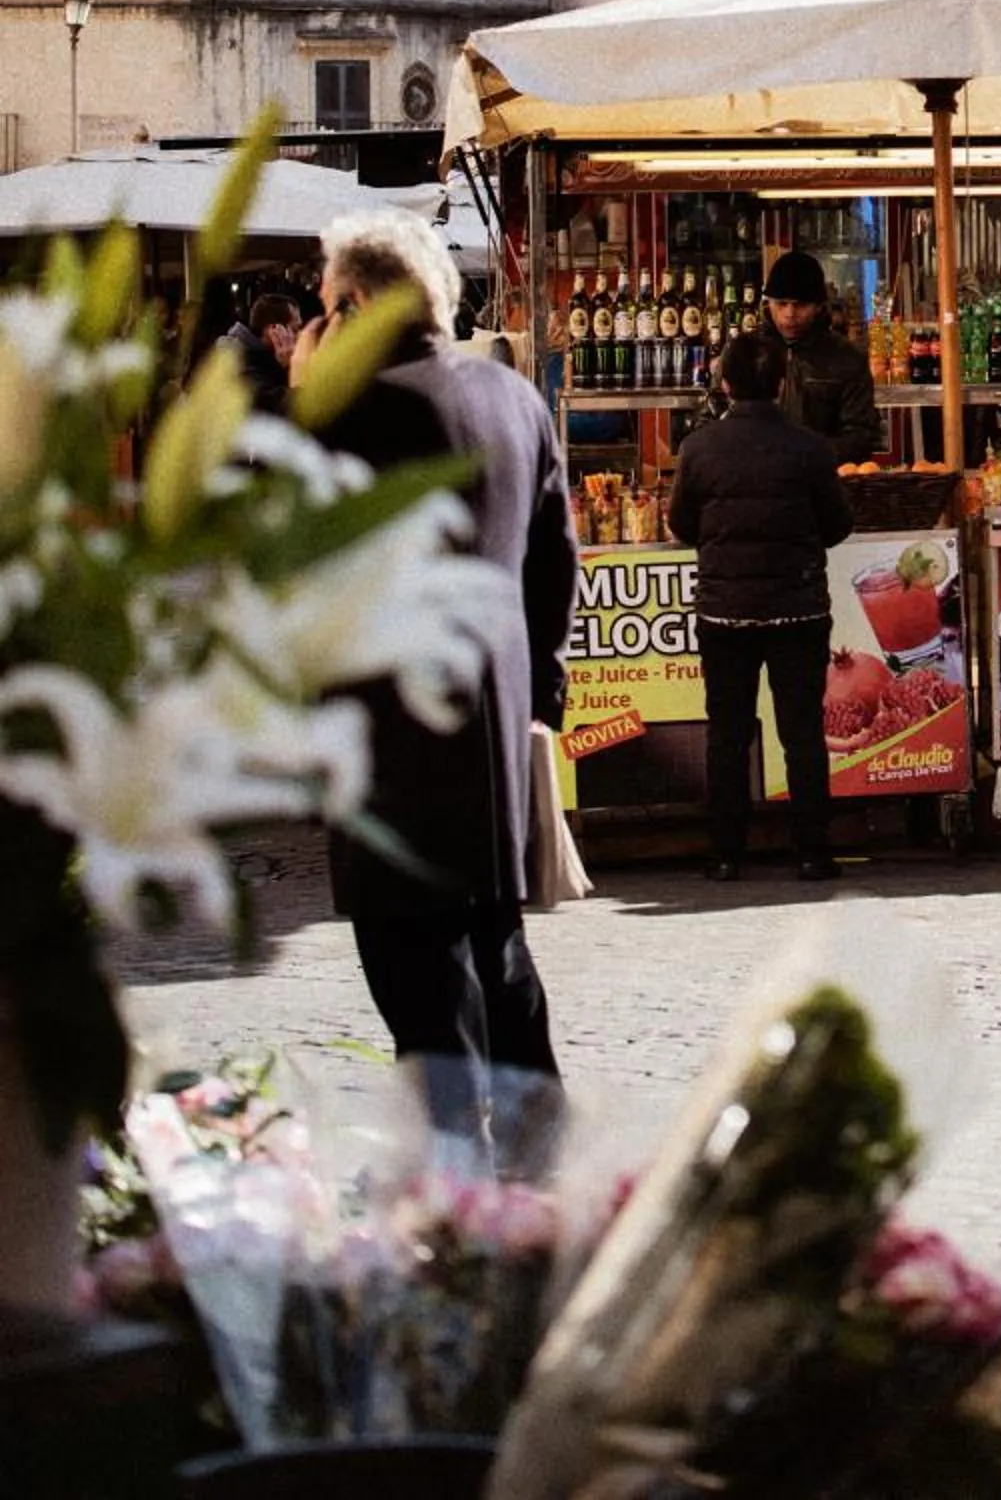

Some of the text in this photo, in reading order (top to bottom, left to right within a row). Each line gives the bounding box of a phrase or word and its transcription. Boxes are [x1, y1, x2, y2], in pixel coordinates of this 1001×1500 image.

[595, 664, 649, 684] Juice
[578, 691, 632, 710] Juice
[887, 743, 953, 769] Claudio
